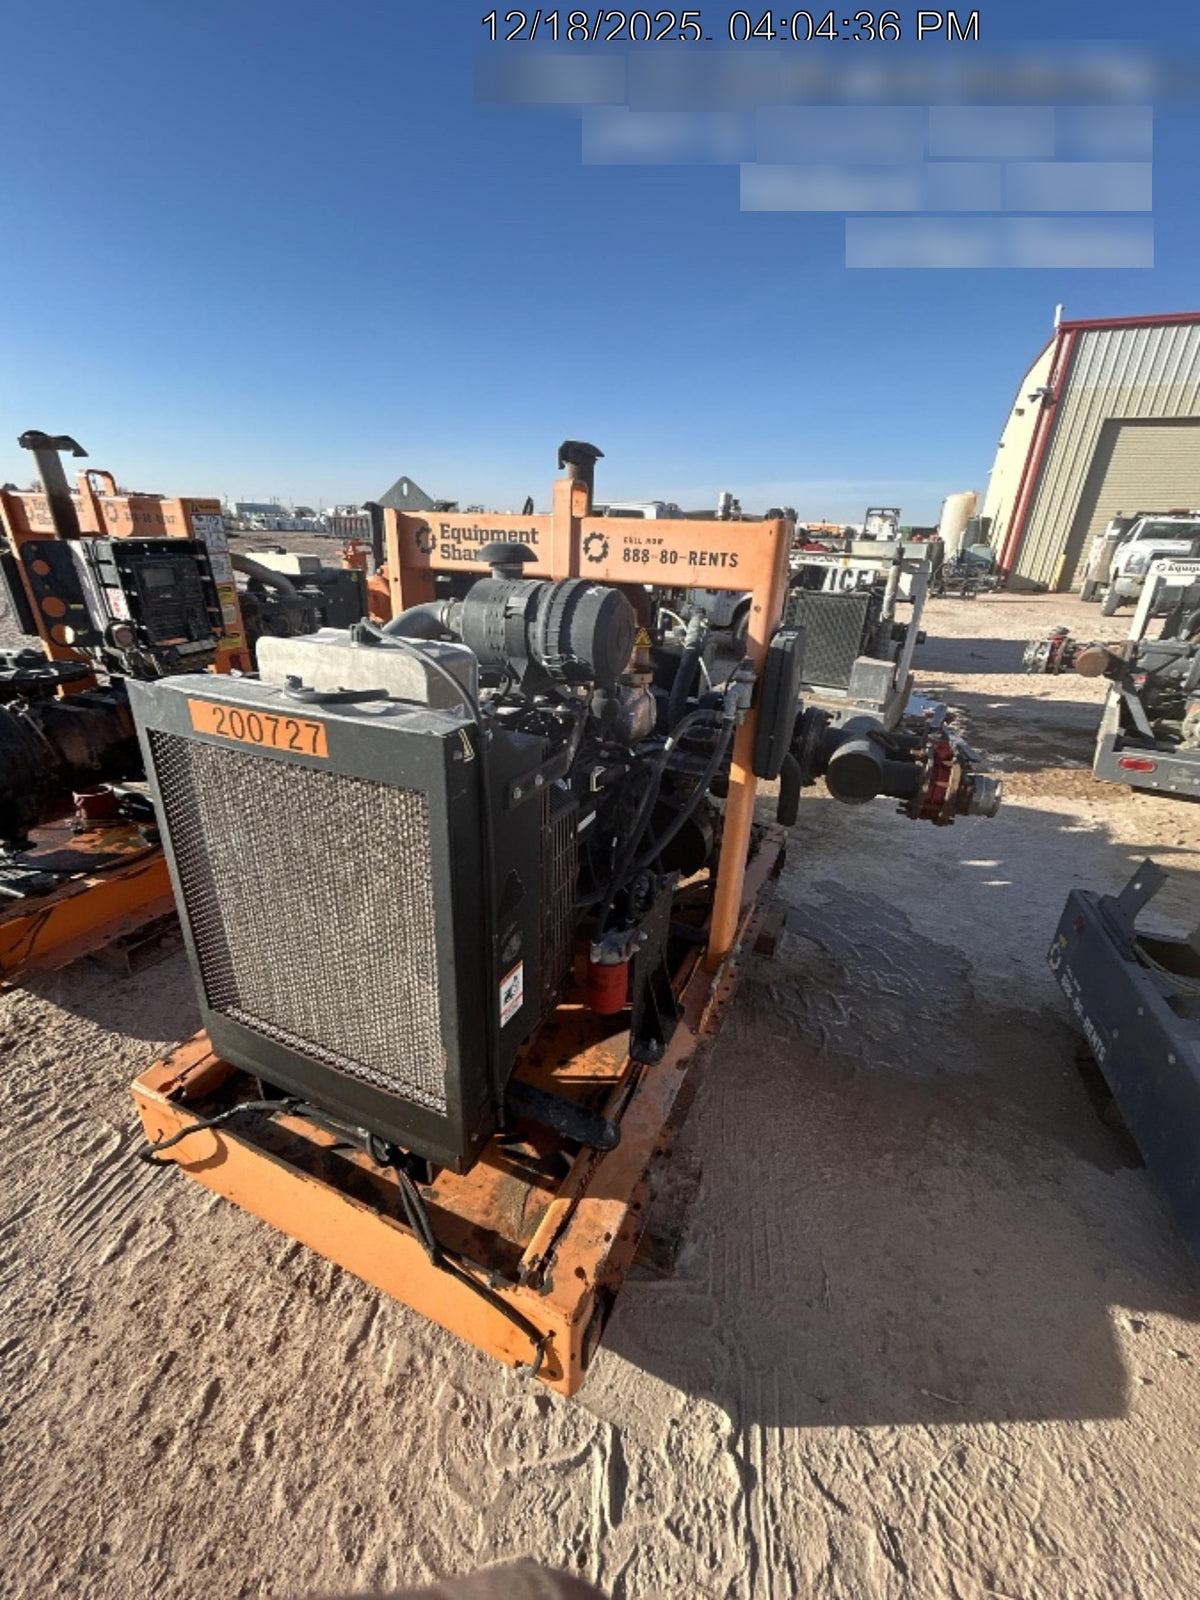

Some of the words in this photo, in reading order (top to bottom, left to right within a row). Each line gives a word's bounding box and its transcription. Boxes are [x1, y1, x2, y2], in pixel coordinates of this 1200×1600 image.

[440, 523, 539, 545] Equipment
[440, 543, 481, 561] Shar
[622, 547, 739, 568] 888-80-RENTS
[212, 706, 320, 753] 200727
